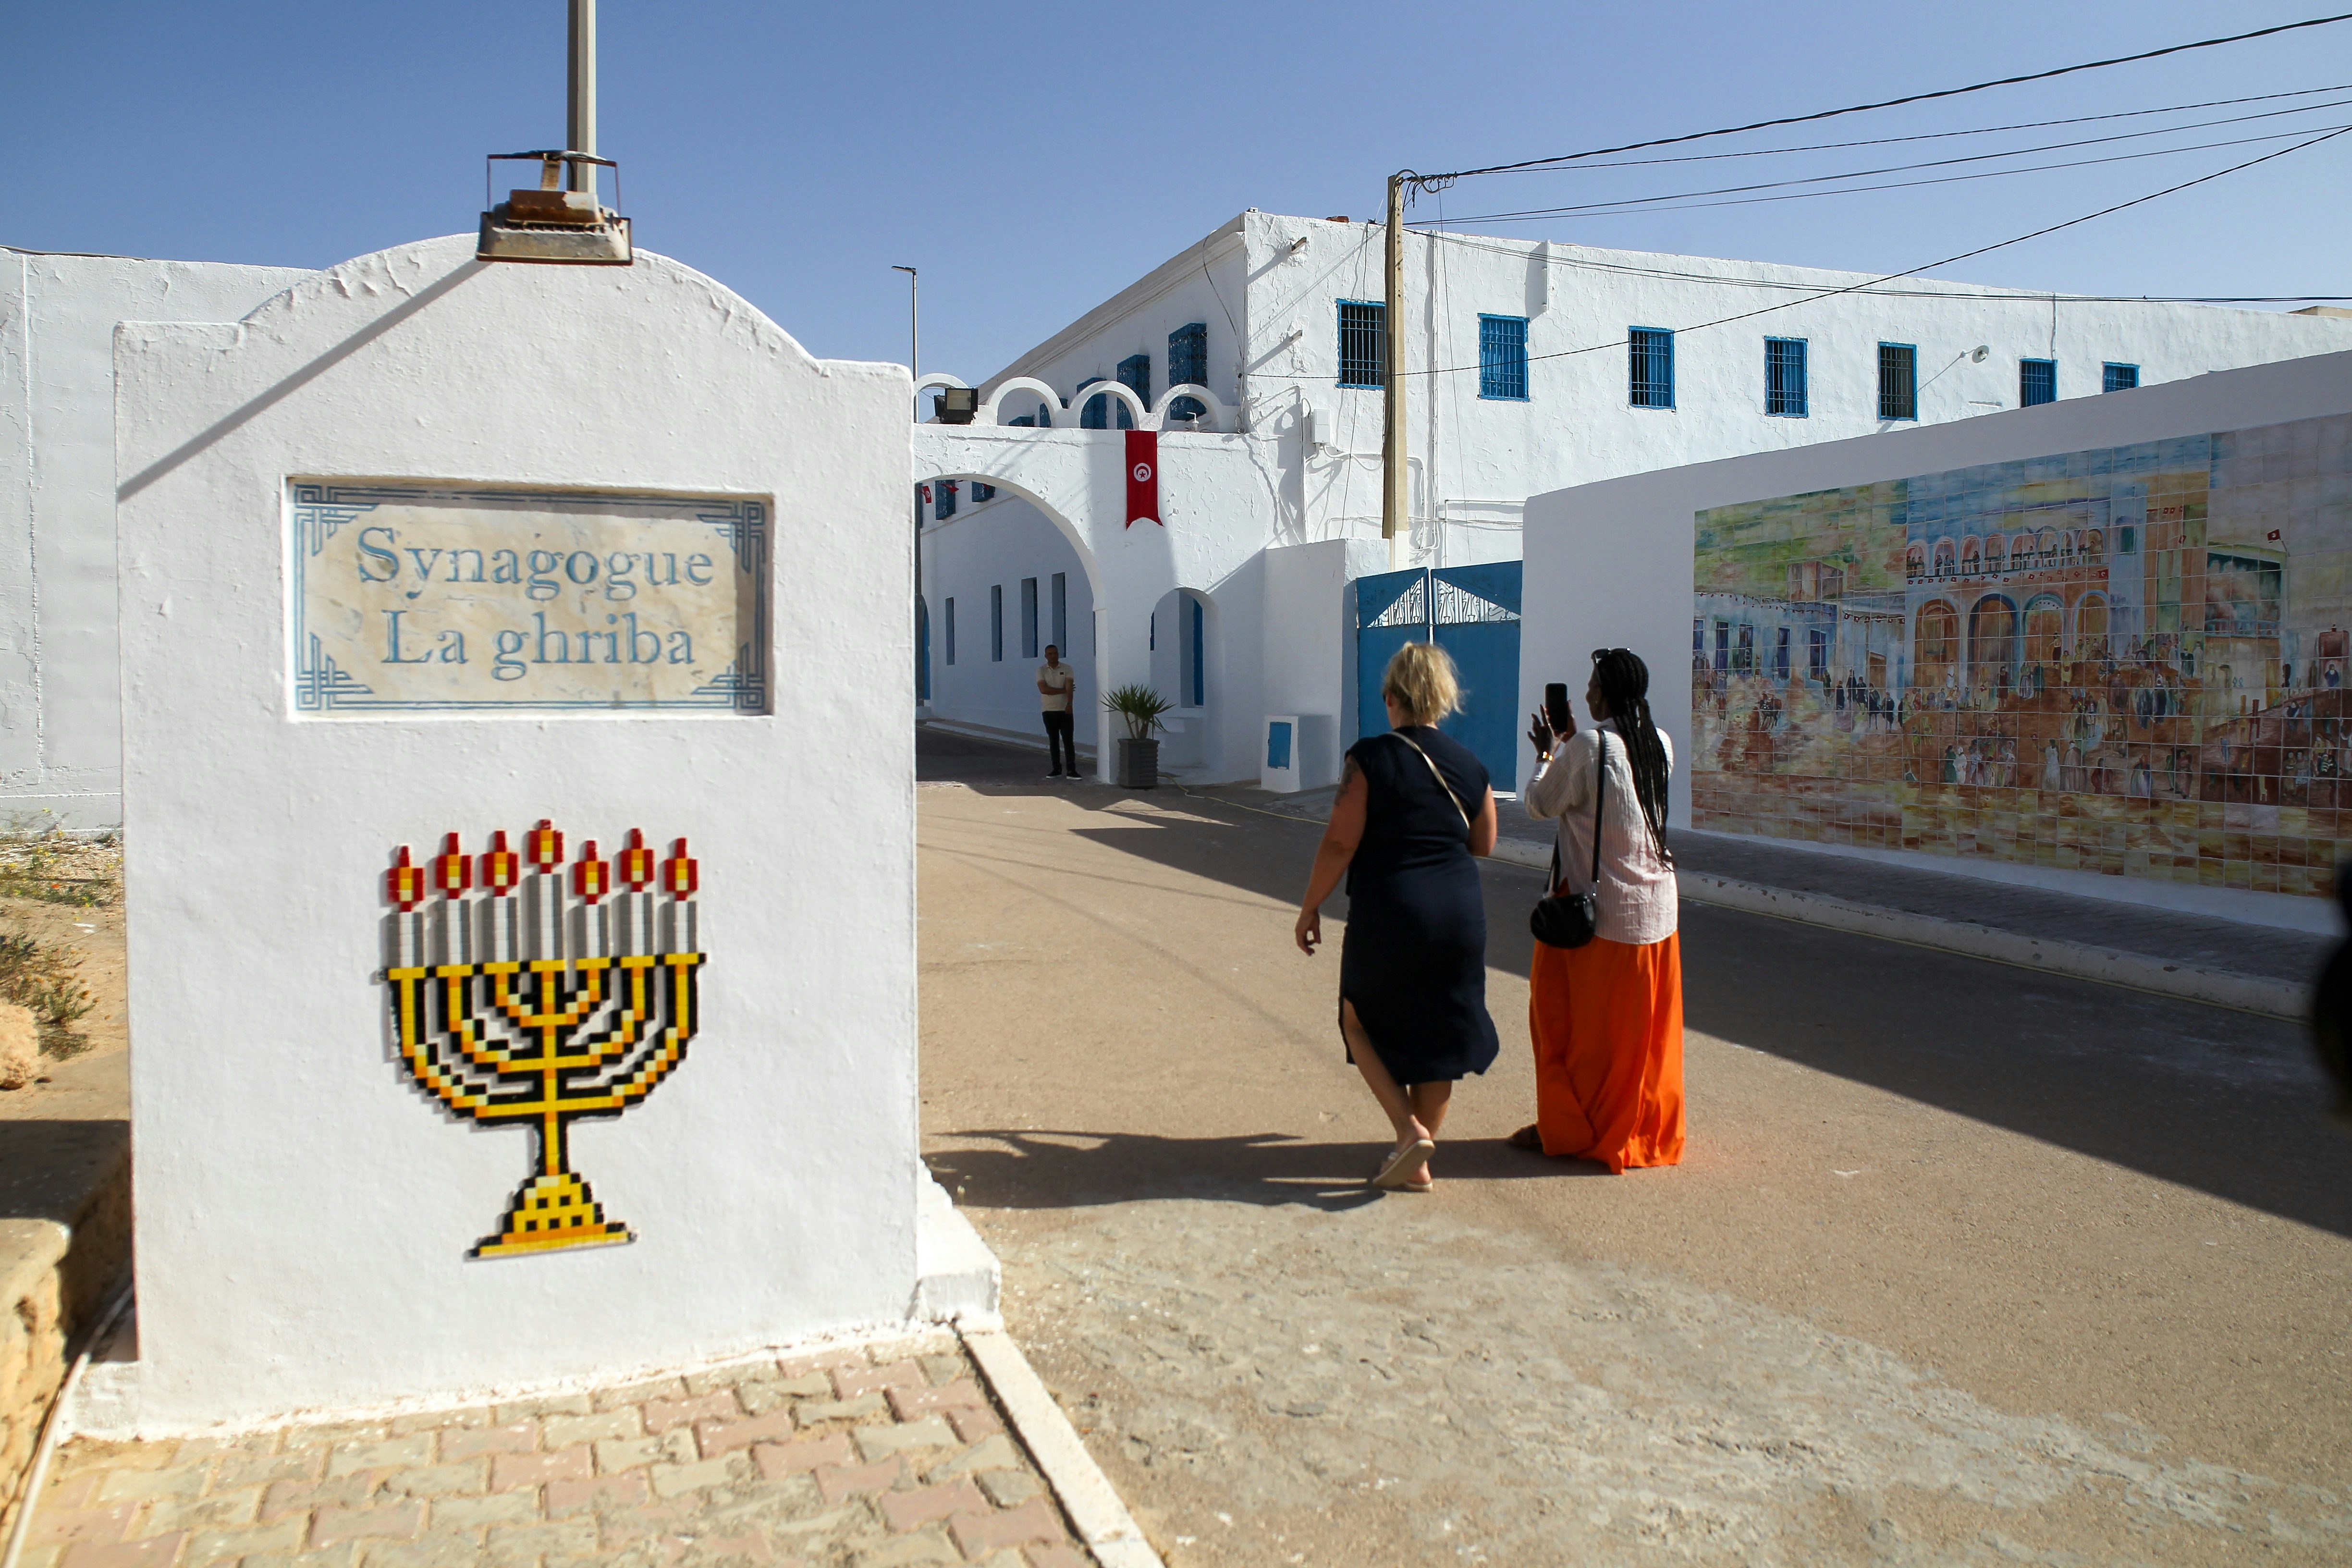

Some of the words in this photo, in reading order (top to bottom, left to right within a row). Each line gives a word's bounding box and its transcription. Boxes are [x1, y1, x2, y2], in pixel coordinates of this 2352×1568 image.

[357, 527, 714, 601] Synagogue
[381, 609, 469, 664] La
[490, 611, 696, 681] ghriba
